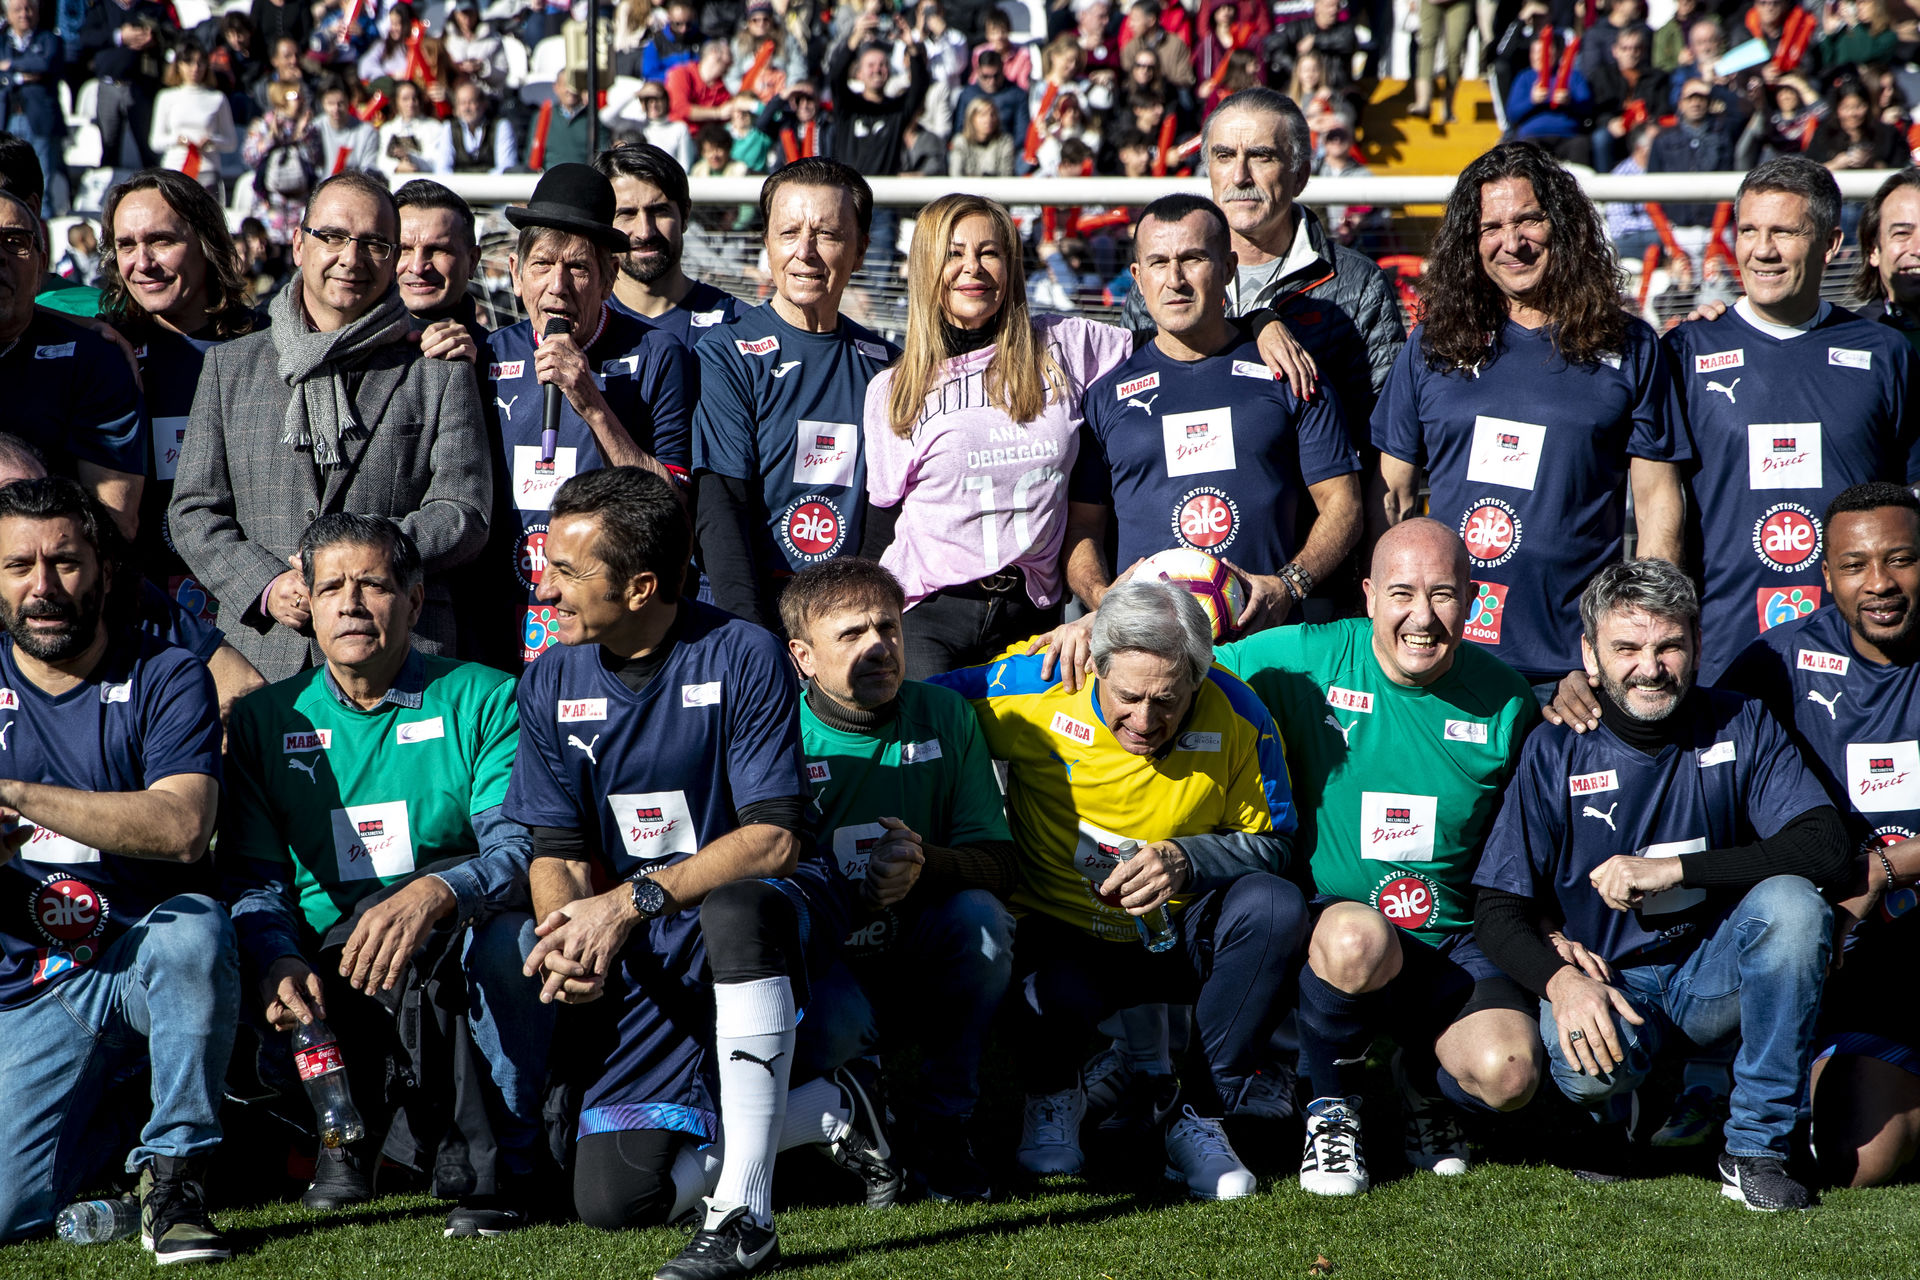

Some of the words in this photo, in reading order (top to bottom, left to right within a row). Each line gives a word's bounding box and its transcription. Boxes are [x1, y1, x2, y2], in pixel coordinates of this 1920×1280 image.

[741, 339, 776, 354] MARCA
[1700, 353, 1739, 369] MARCA
[1121, 376, 1156, 396] MARCA
[989, 424, 1029, 443] ANA
[1176, 435, 1222, 461] Direct
[804, 450, 848, 468] Direct
[1762, 452, 1810, 473] Direct
[799, 494, 838, 512] ARTISTAS
[1183, 486, 1226, 502] ARTISTAS
[1473, 497, 1515, 515] ARTISTAS
[1766, 502, 1811, 517] ARTISTAS
[792, 508, 834, 544] aie
[1183, 501, 1228, 535] aie
[1213, 500, 1240, 554] EJECUTANTES
[804, 554, 812, 562] O
[813, 514, 847, 562] EJECUTANTES
[1467, 511, 1510, 547] aie
[1765, 516, 1811, 551] aie
[1487, 518, 1522, 568] EJECUTANTES
[1784, 565, 1794, 574] O
[1472, 627, 1498, 640] 6000
[286, 732, 326, 749] MARCA
[807, 765, 827, 779] RCA
[1859, 772, 1911, 796] Direct
[630, 819, 679, 842] Direct
[1372, 824, 1423, 844] Direct
[42, 886, 95, 926] aie
[1382, 884, 1430, 918] aie
[1425, 880, 1440, 929] ECUTANTES
